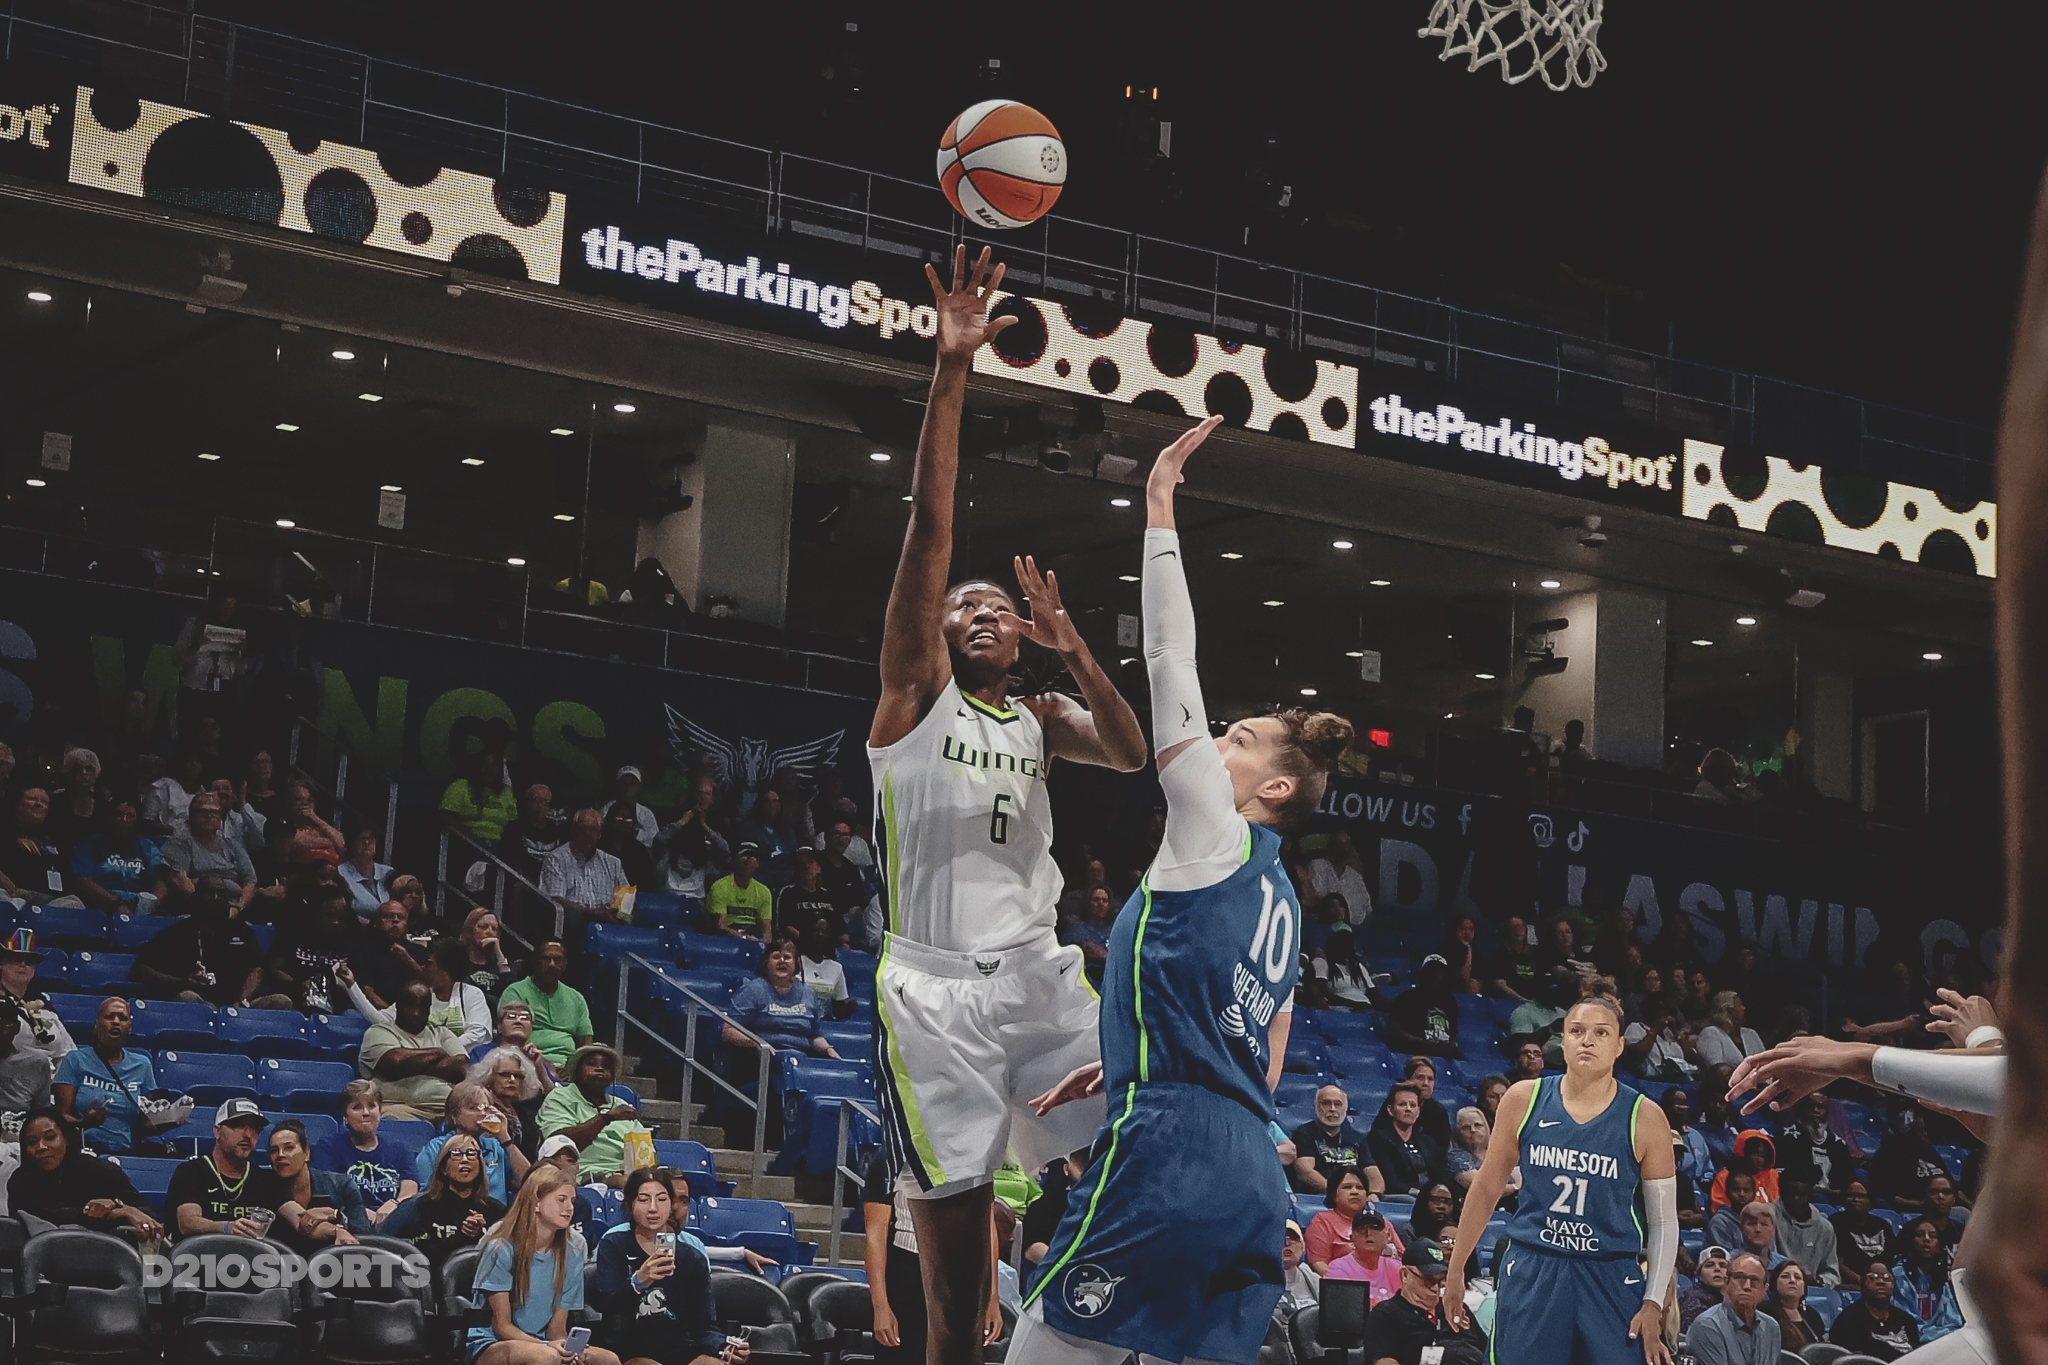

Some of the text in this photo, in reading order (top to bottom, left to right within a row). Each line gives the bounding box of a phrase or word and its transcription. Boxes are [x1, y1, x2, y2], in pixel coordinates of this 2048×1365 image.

[581, 225, 937, 339] theParkingSpo
[1369, 393, 1676, 490] theParkingSpot
[990, 793, 1011, 845] 6
[1402, 801, 1437, 830] US
[1248, 873, 1294, 984] 10
[1232, 961, 1276, 1027] SHEPARD
[1529, 1143, 1618, 1180] MINNESOTA
[211, 1201, 253, 1218] TEAS
[1548, 1174, 1589, 1217] 21
[1539, 1228, 1600, 1252] CLINIC
[1545, 1215, 1594, 1237] MAYO
